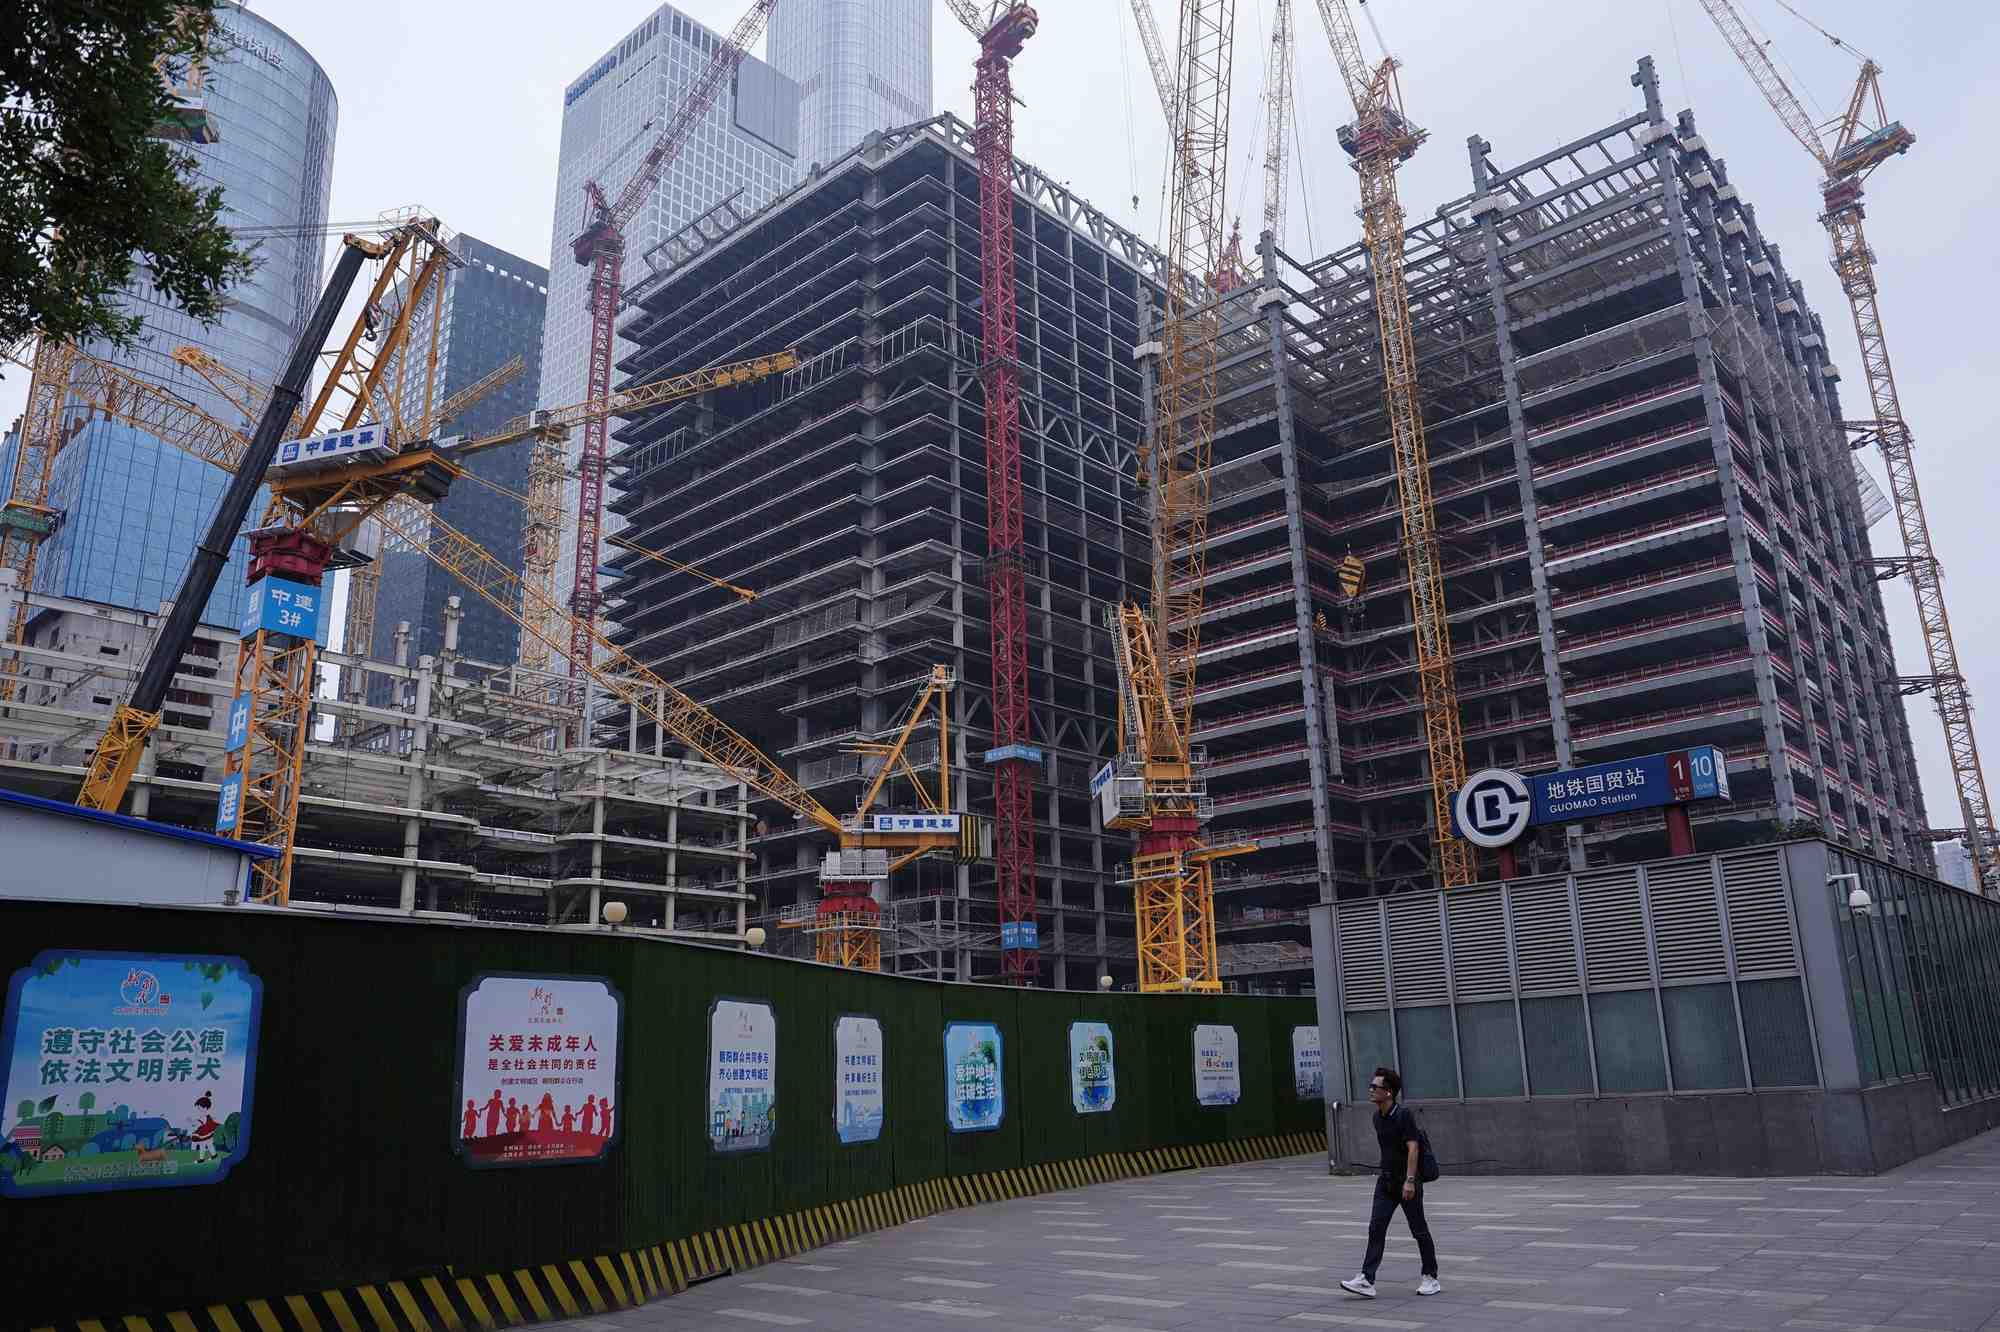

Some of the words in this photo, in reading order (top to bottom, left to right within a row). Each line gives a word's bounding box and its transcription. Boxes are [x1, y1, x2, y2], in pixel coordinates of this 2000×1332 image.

[279, 609, 301, 628] 3#
[231, 703, 247, 743] 中
[1673, 760, 1683, 780] 1
[1691, 756, 1711, 777] 10
[1547, 768, 1645, 800] 地铁国贸站
[1550, 800, 1597, 813] GUOMAO
[1601, 793, 1637, 806] Station
[42, 1028, 226, 1056] 遵守社会公德
[488, 1033, 598, 1053] 关爱未成年人
[40, 1056, 222, 1085] 依法文明养犬
[487, 1057, 598, 1071] 是全社会共同的责任
